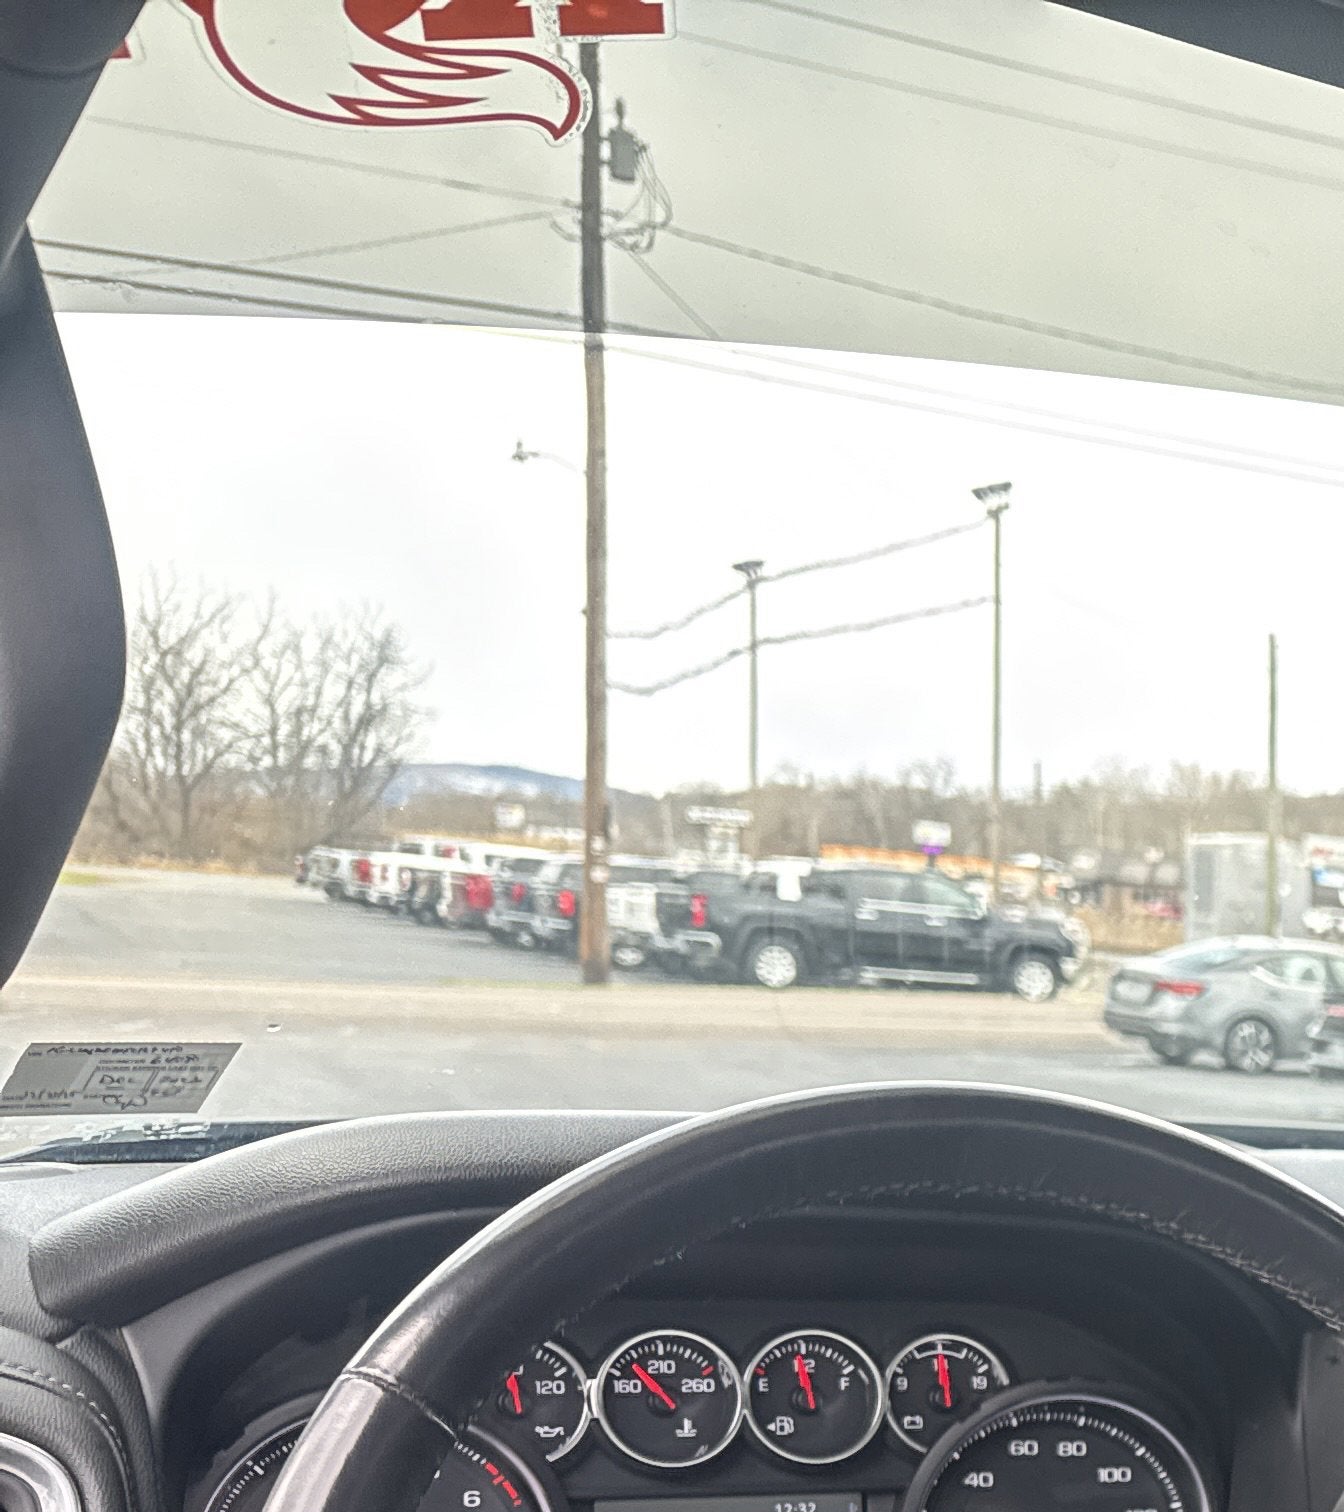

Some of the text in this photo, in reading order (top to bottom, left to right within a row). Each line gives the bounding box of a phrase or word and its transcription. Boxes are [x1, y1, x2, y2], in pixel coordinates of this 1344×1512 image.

[647, 1360, 676, 1374] 210
[535, 1380, 566, 1395] 120
[613, 1380, 642, 1393] 160
[681, 1379, 715, 1393] 260
[758, 1378, 769, 1392] E
[840, 1377, 850, 1391] F
[897, 1376, 908, 1391] 9
[972, 1375, 988, 1390] 19
[1010, 1440, 1038, 1456] 60
[1057, 1441, 1087, 1457] 80
[964, 1471, 994, 1487] 40
[1097, 1467, 1131, 1483] 100
[463, 1490, 481, 1508] 6
